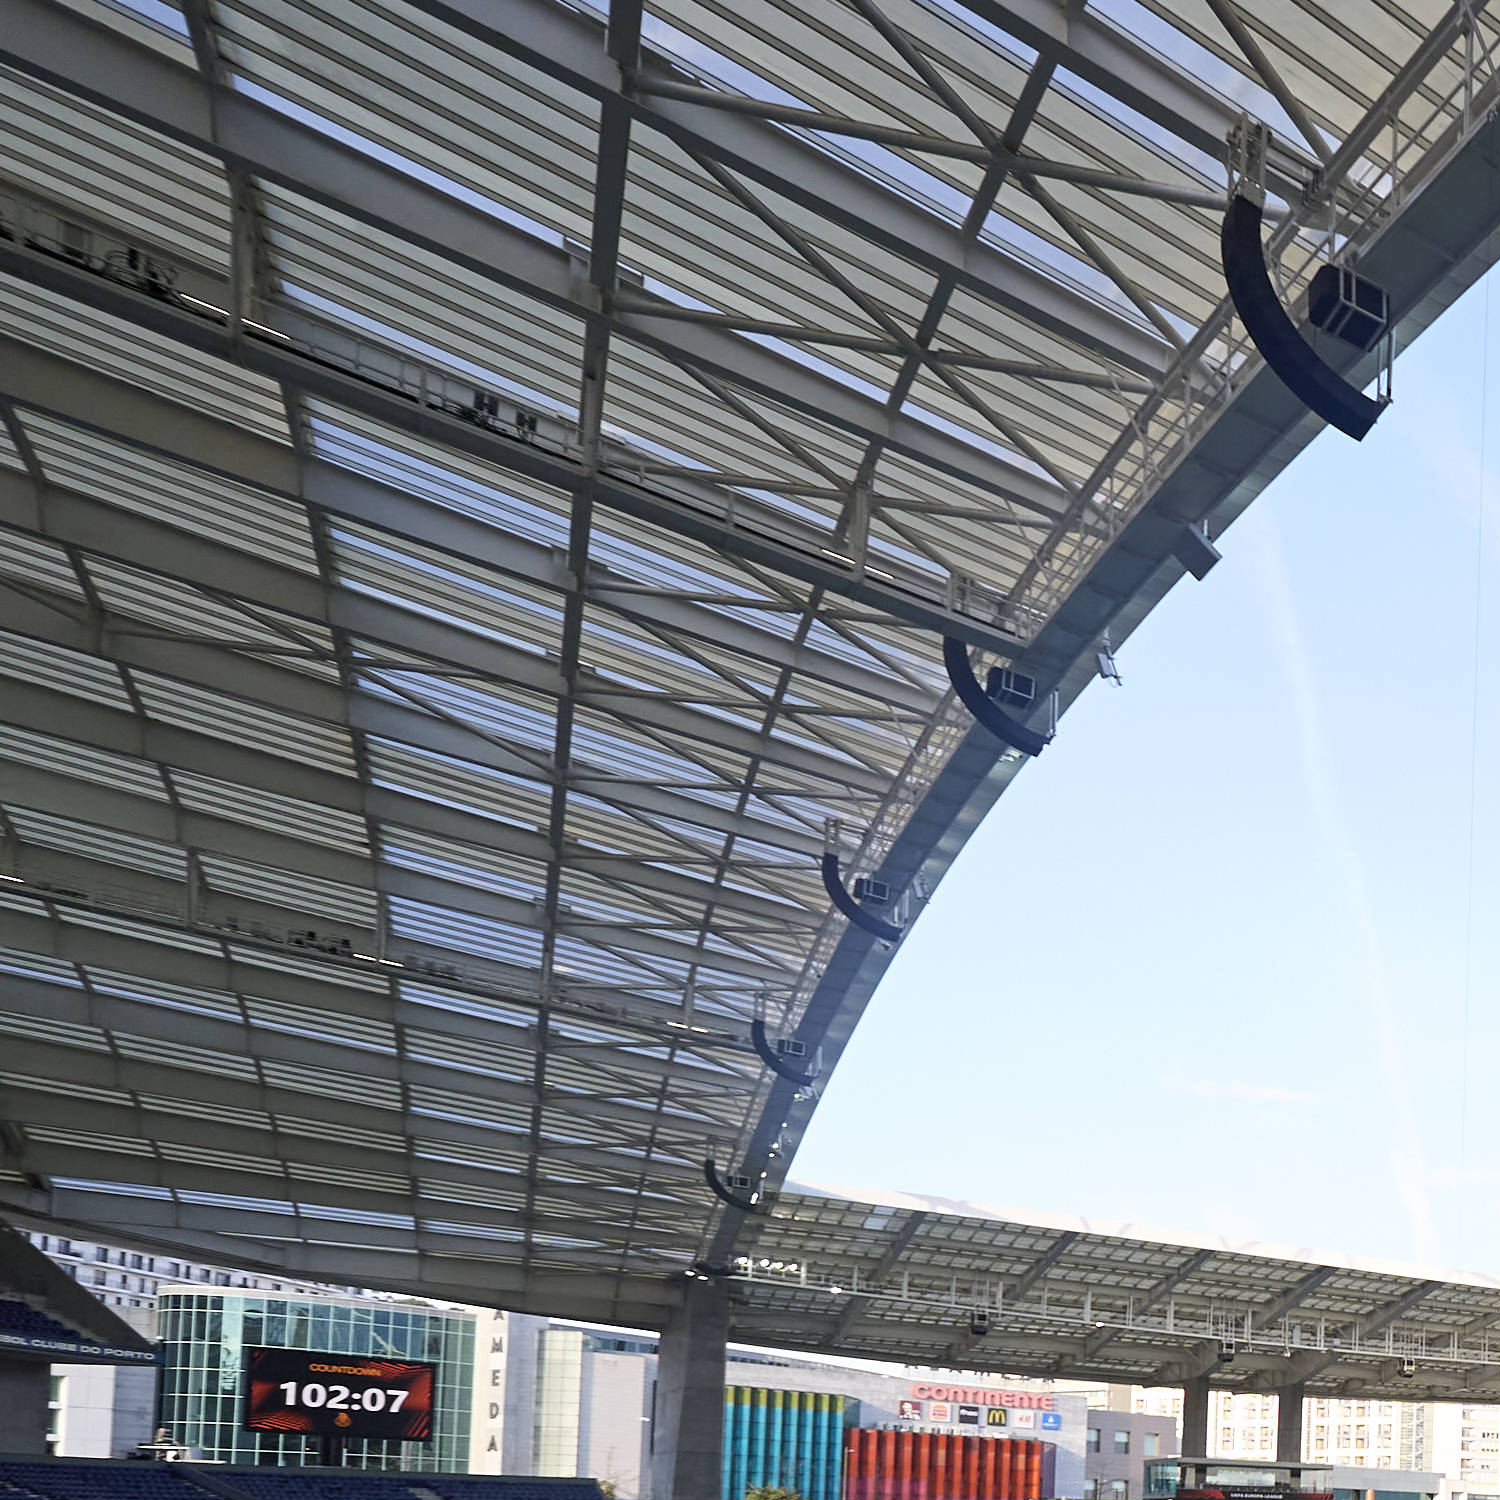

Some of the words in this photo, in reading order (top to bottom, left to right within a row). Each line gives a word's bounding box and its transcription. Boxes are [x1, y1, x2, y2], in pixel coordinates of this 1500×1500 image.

[31, 1339, 77, 1351] CLUBE
[80, 1346, 101, 1354] DO
[104, 1348, 155, 1360] PORTO
[309, 1363, 382, 1377] COUNTDOWN
[280, 1381, 409, 1413] 102:07
